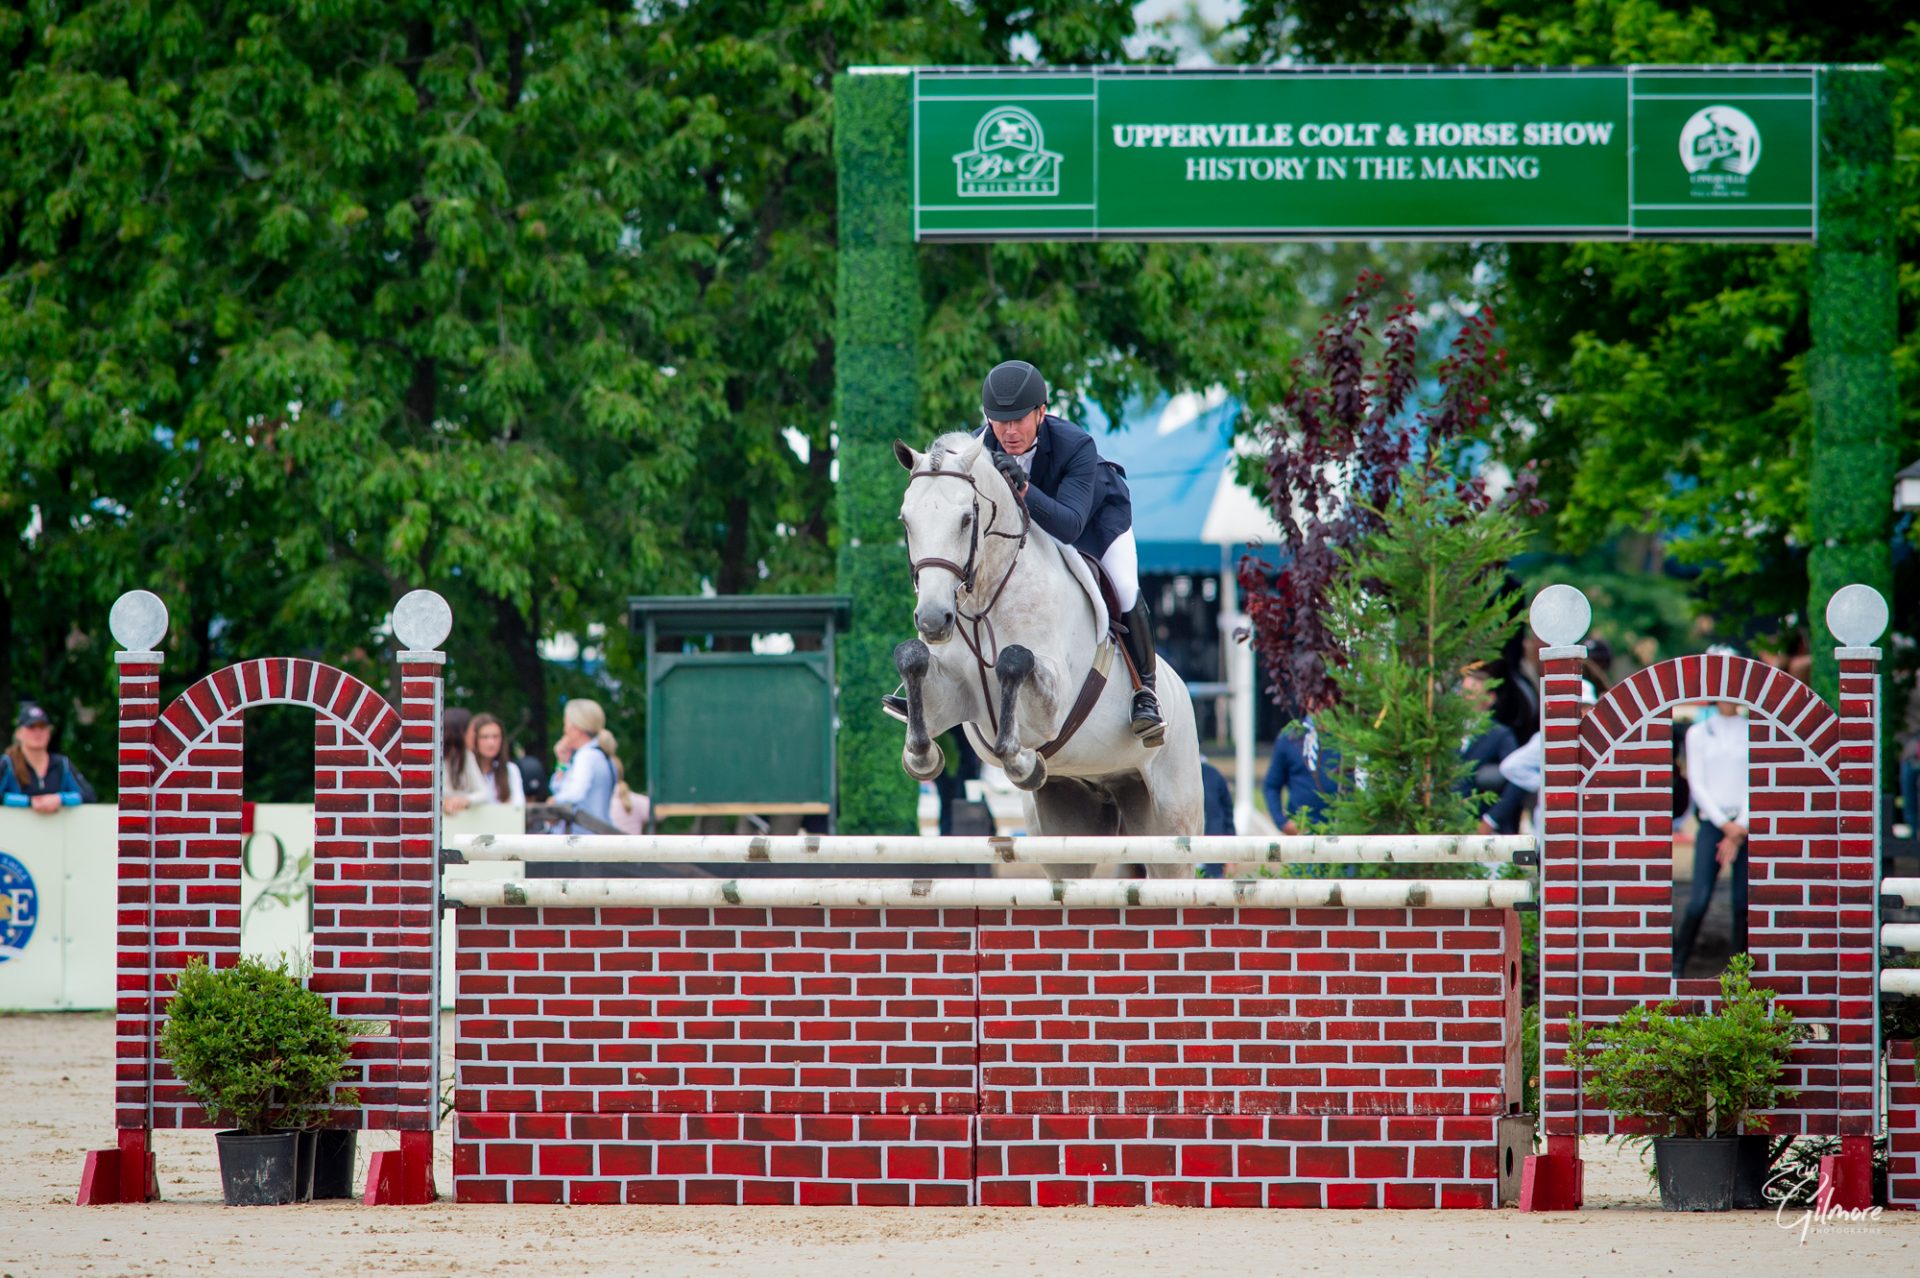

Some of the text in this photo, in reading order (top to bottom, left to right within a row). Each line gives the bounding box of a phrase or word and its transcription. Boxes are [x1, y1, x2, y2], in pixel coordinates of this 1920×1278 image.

[1112, 122, 1614, 148] UPPERVILLE COLT & HORSE SHOW
[1185, 156, 1540, 181] HISTORY IN THE MAKING
